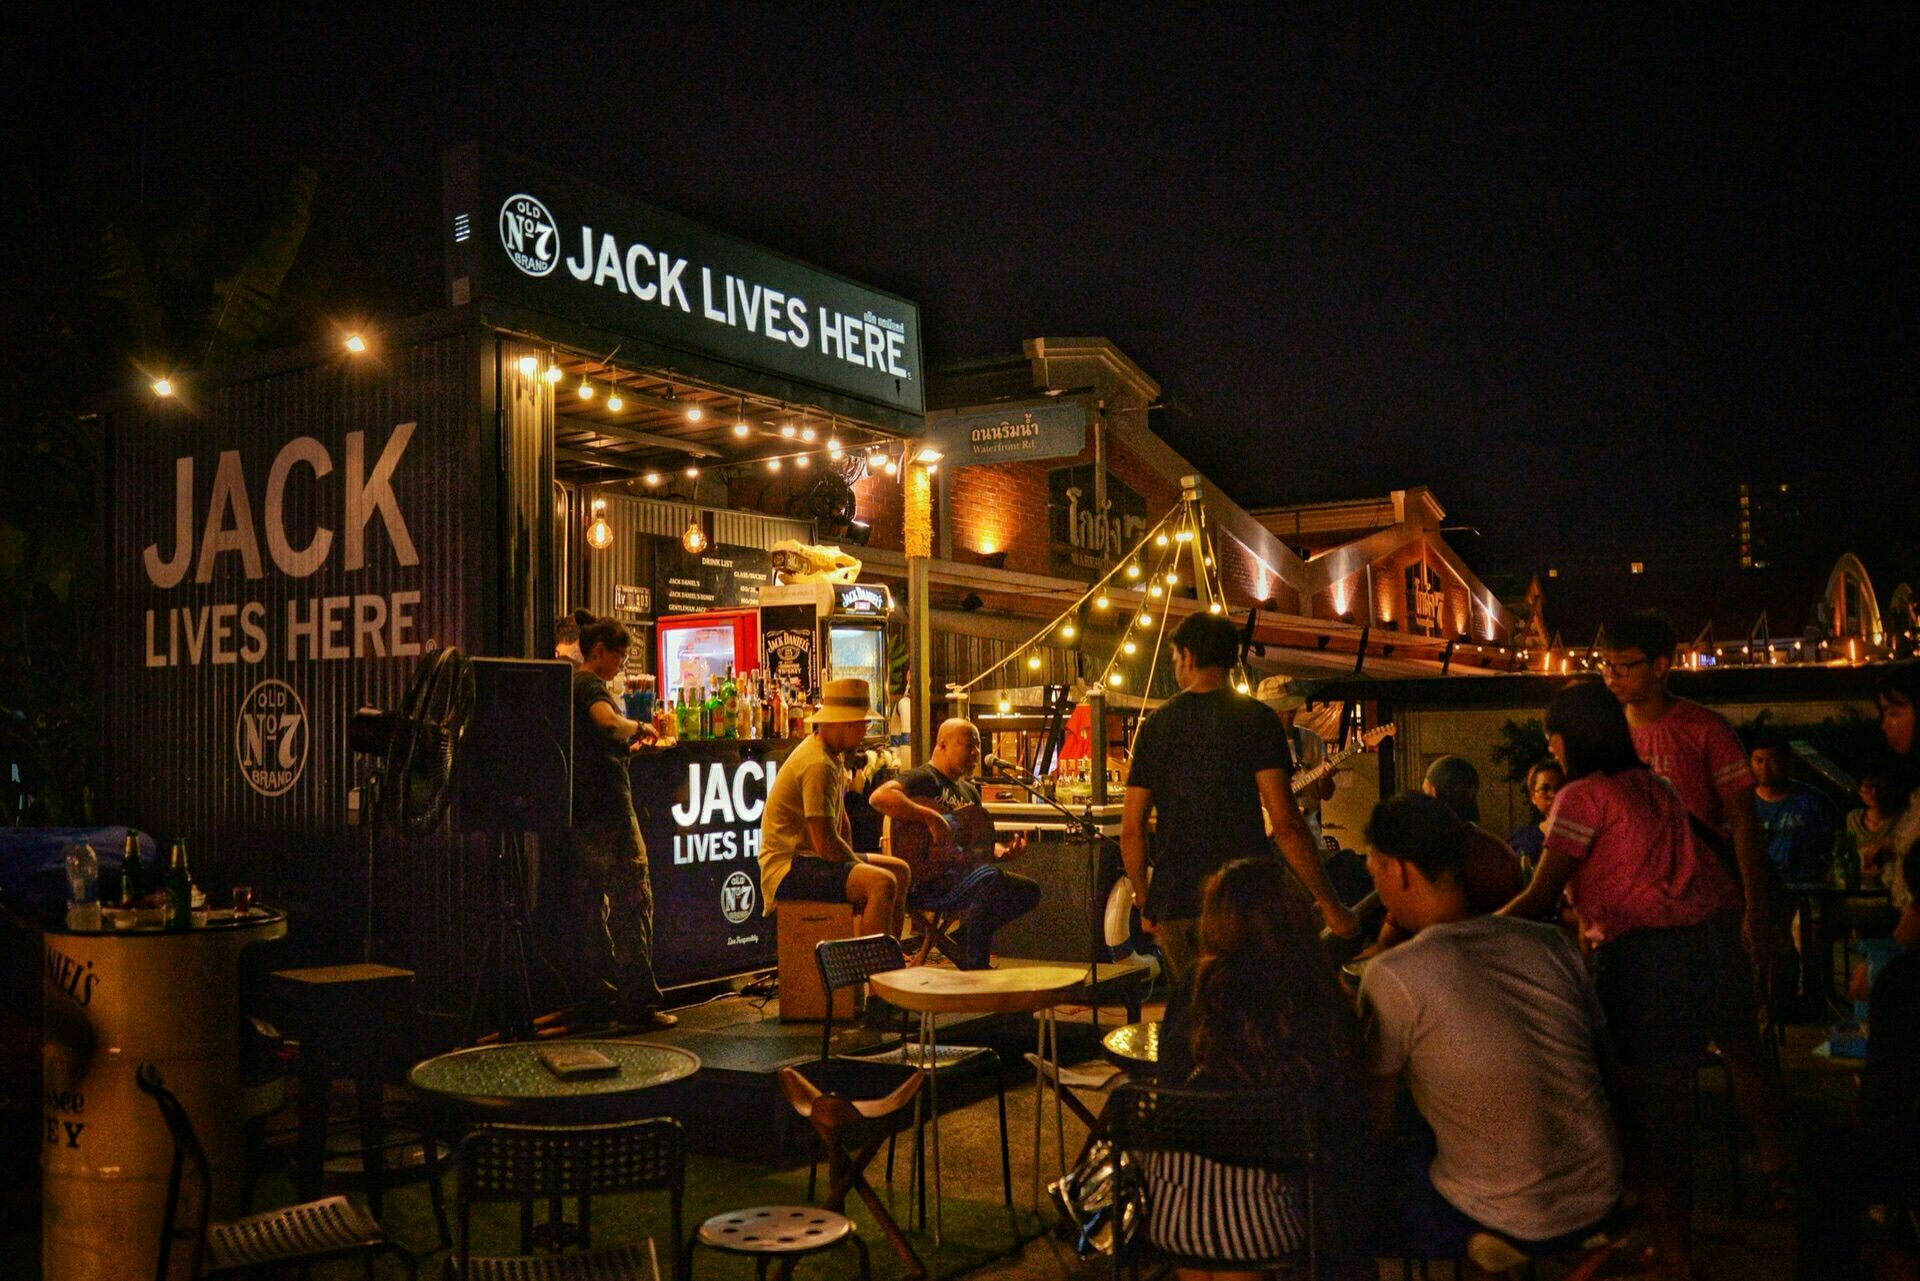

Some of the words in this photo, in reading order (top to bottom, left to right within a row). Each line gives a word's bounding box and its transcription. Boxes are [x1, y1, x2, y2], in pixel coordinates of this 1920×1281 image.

[517, 201, 541, 219] OLD
[514, 252, 548, 271] BRAND
[566, 225, 690, 313] JACK
[702, 267, 810, 348] LIVES
[819, 306, 908, 379] HERE
[971, 412, 1039, 442] ถนนริมน้ำ
[973, 441, 1021, 454] Waterfront
[143, 421, 420, 589] JACK
[841, 589, 858, 608] JACK
[145, 600, 269, 668] LIVES
[287, 590, 421, 662] HERE
[767, 635, 784, 653] JACK
[258, 688, 286, 708] OLD
[251, 769, 293, 789] BRAND
[673, 831, 738, 865] LIVES
